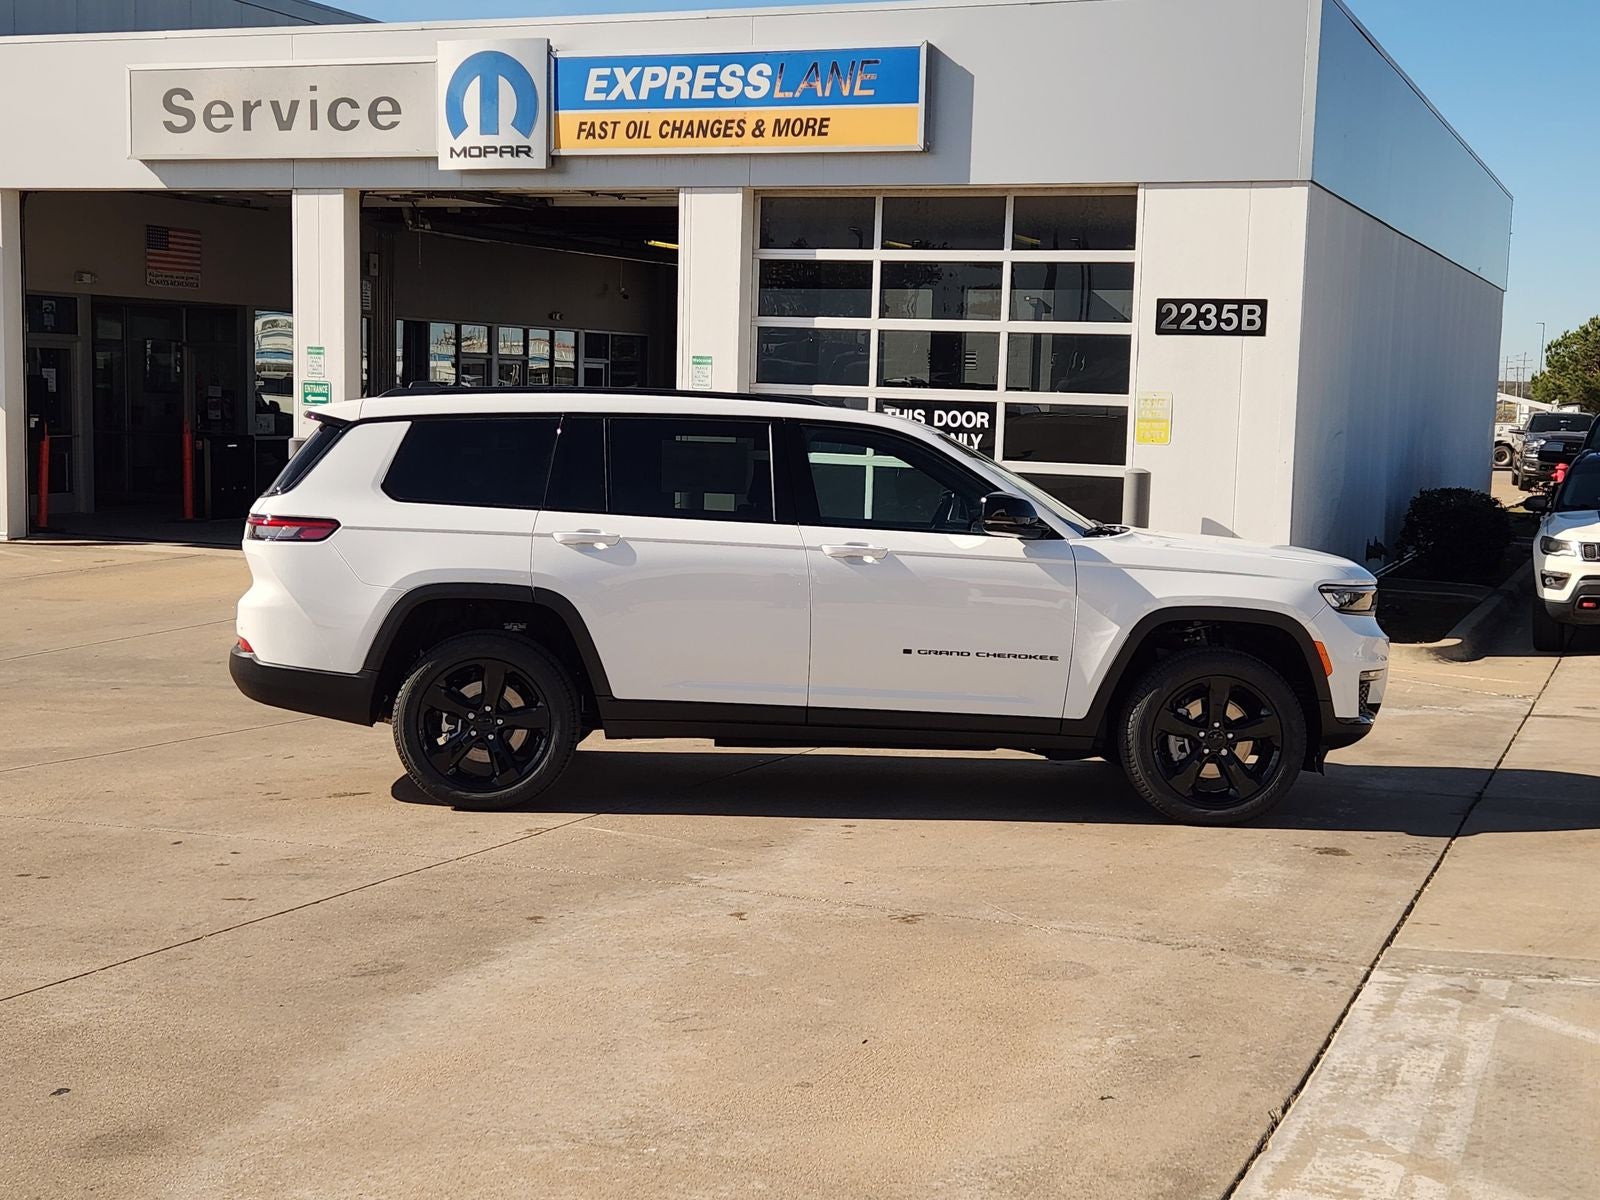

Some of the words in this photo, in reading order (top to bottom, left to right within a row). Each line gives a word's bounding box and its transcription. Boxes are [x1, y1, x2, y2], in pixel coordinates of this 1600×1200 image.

[584, 65, 772, 101] EXPRESS
[774, 59, 880, 97] LANE
[162, 85, 402, 134] Service
[576, 121, 621, 140] FAST
[626, 120, 652, 139] OIL
[658, 119, 747, 139] CHANGES
[751, 119, 767, 138] &
[771, 117, 831, 137] MORE
[449, 144, 534, 159] MOPAR
[1160, 303, 1262, 331] 2235B
[304, 384, 328, 394] ENTRANCE
[933, 410, 990, 429] DOOR
[917, 649, 971, 657] GRAND
[975, 652, 1060, 661] CHEROKEE
